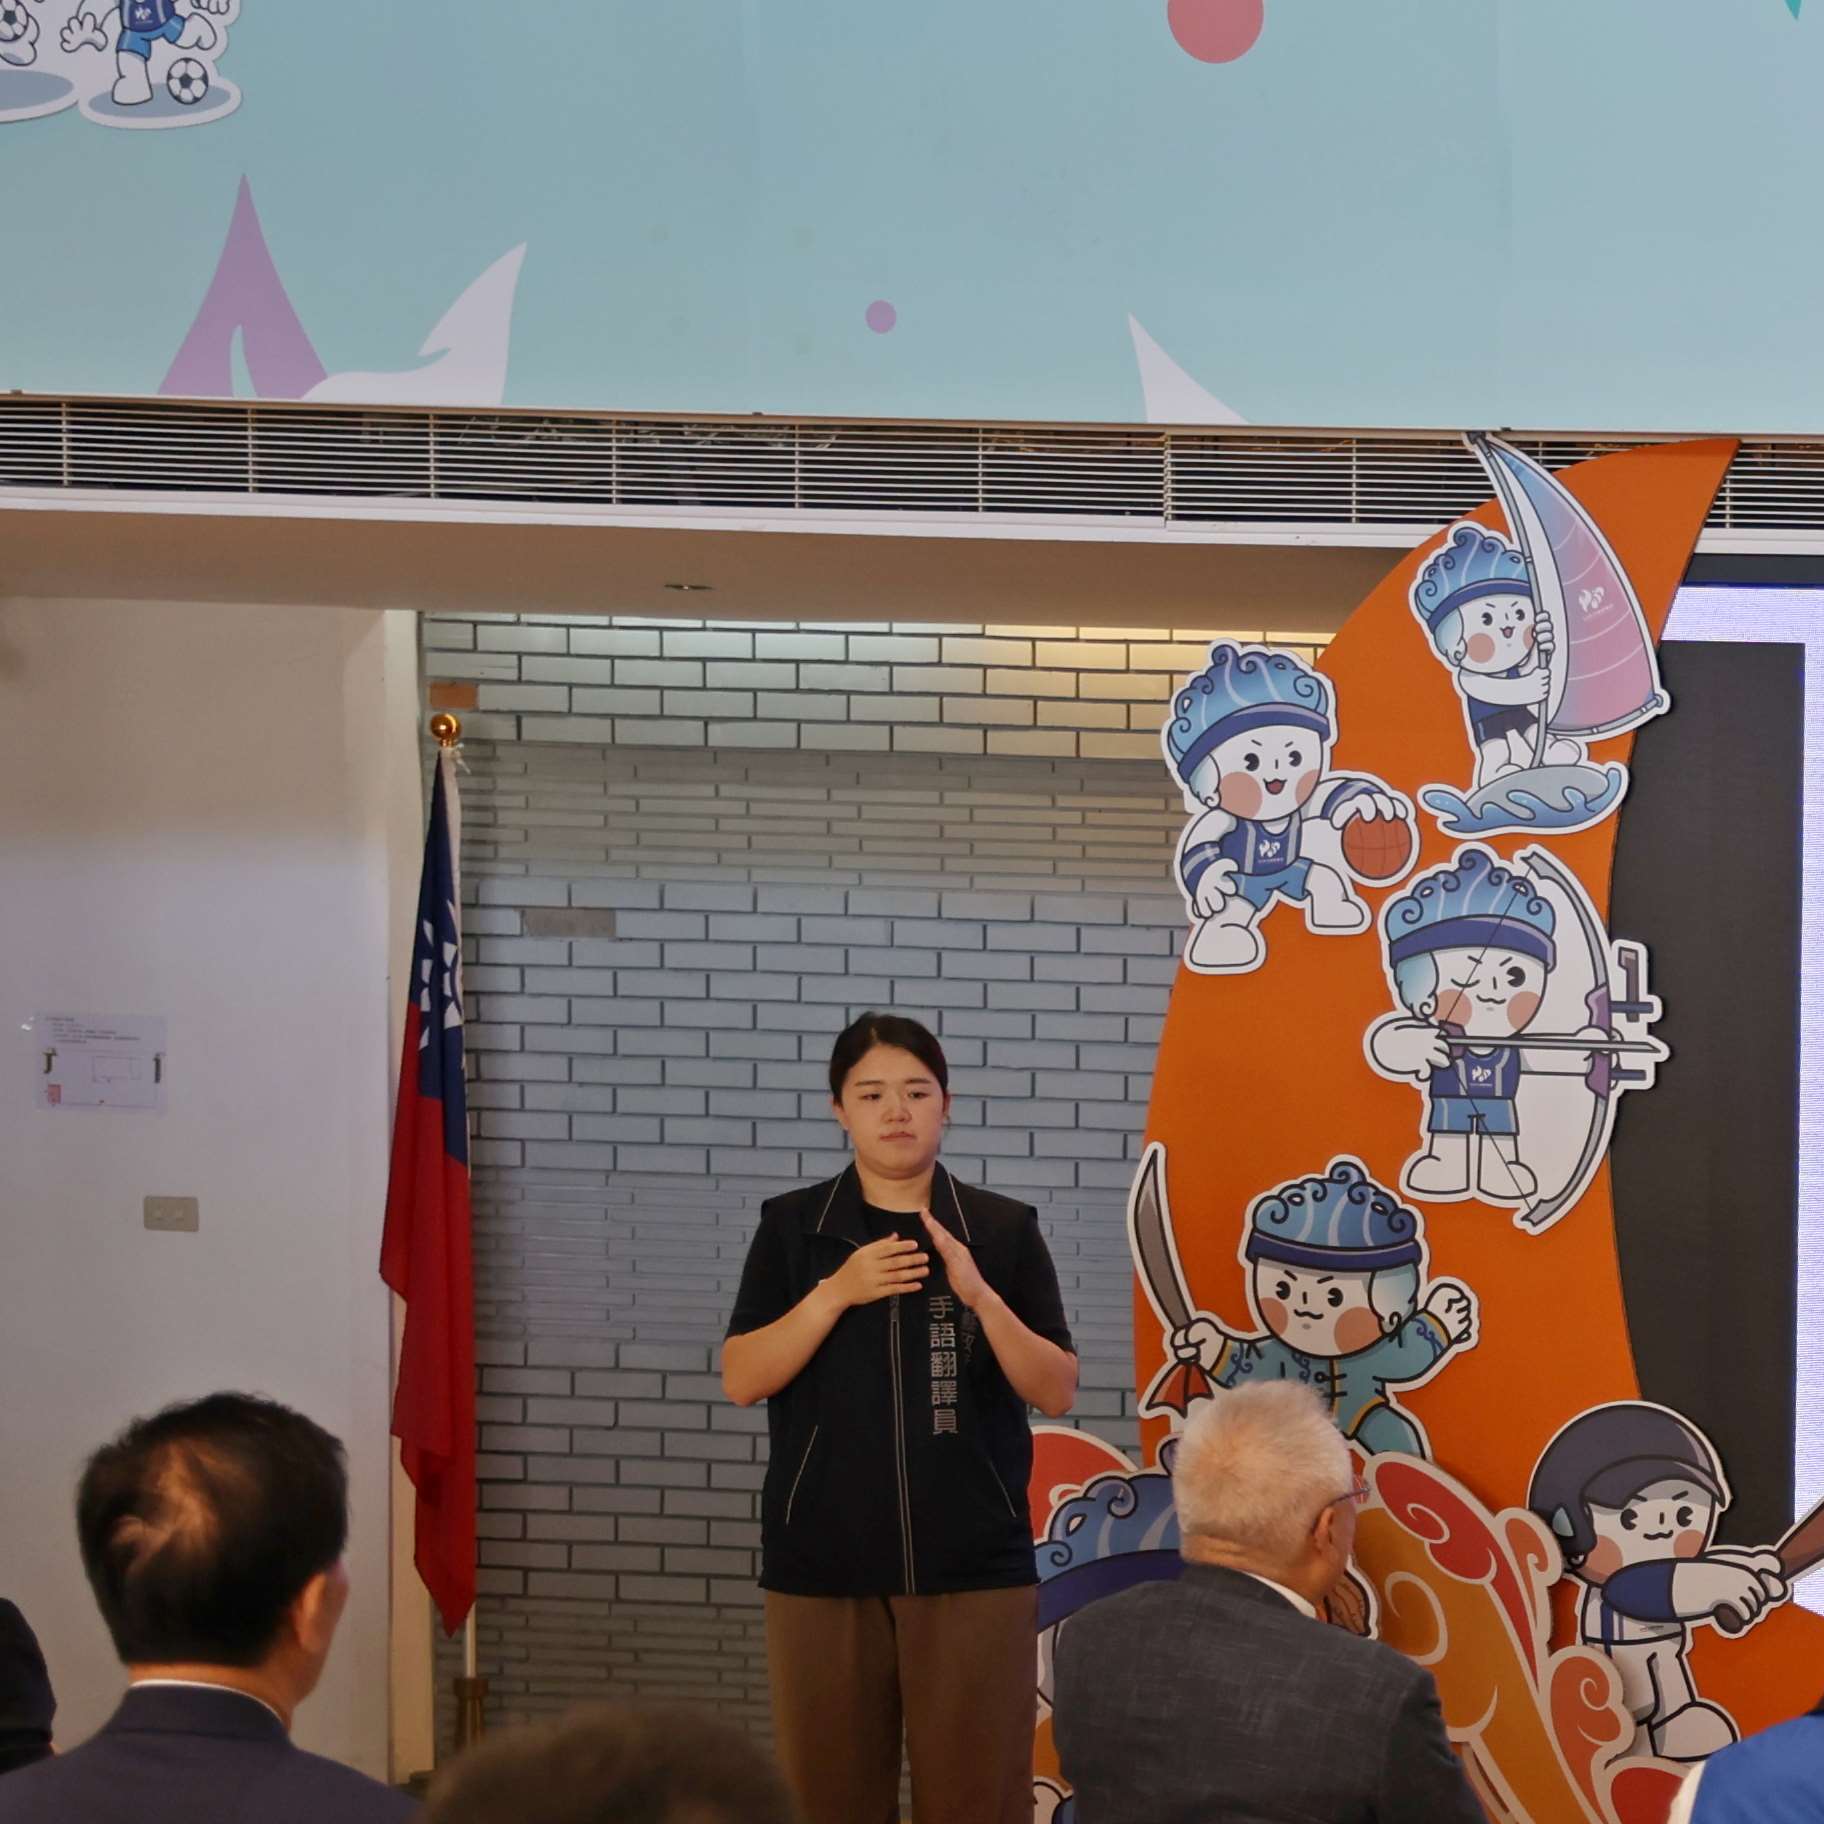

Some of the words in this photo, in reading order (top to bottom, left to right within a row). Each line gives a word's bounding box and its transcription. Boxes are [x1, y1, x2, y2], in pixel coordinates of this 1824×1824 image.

[928, 1295, 959, 1436] 手語翻譯員
